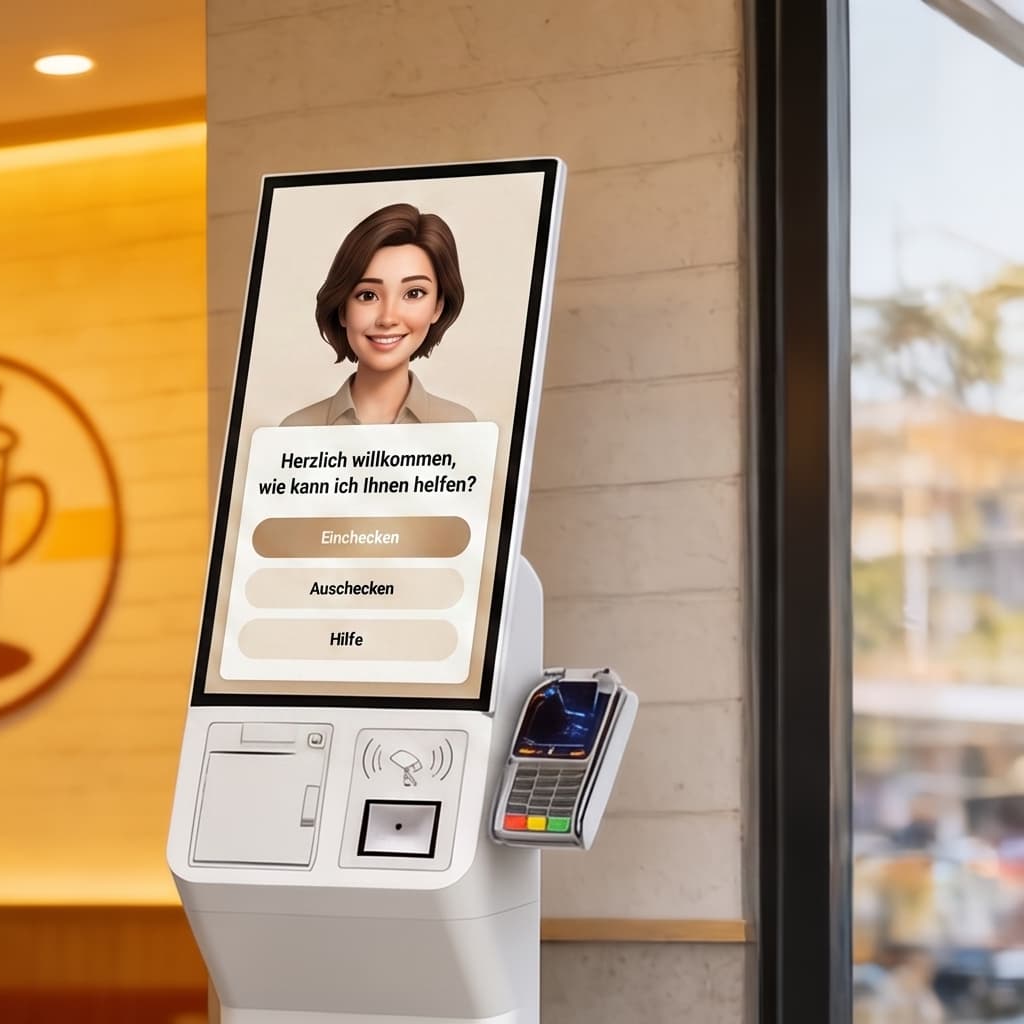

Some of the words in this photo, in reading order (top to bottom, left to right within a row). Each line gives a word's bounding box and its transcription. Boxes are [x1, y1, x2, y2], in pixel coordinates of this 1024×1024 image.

[281, 451, 348, 469] Herzlich
[352, 450, 456, 470] willkommen,
[259, 478, 286, 495] wie
[290, 477, 330, 495] kann
[334, 476, 359, 494] ich
[363, 476, 409, 494] Ihnen
[413, 475, 477, 493] helfen?
[321, 530, 400, 545] Einchecken
[309, 581, 394, 596] Auschecken
[329, 632, 364, 647] Hilfe
